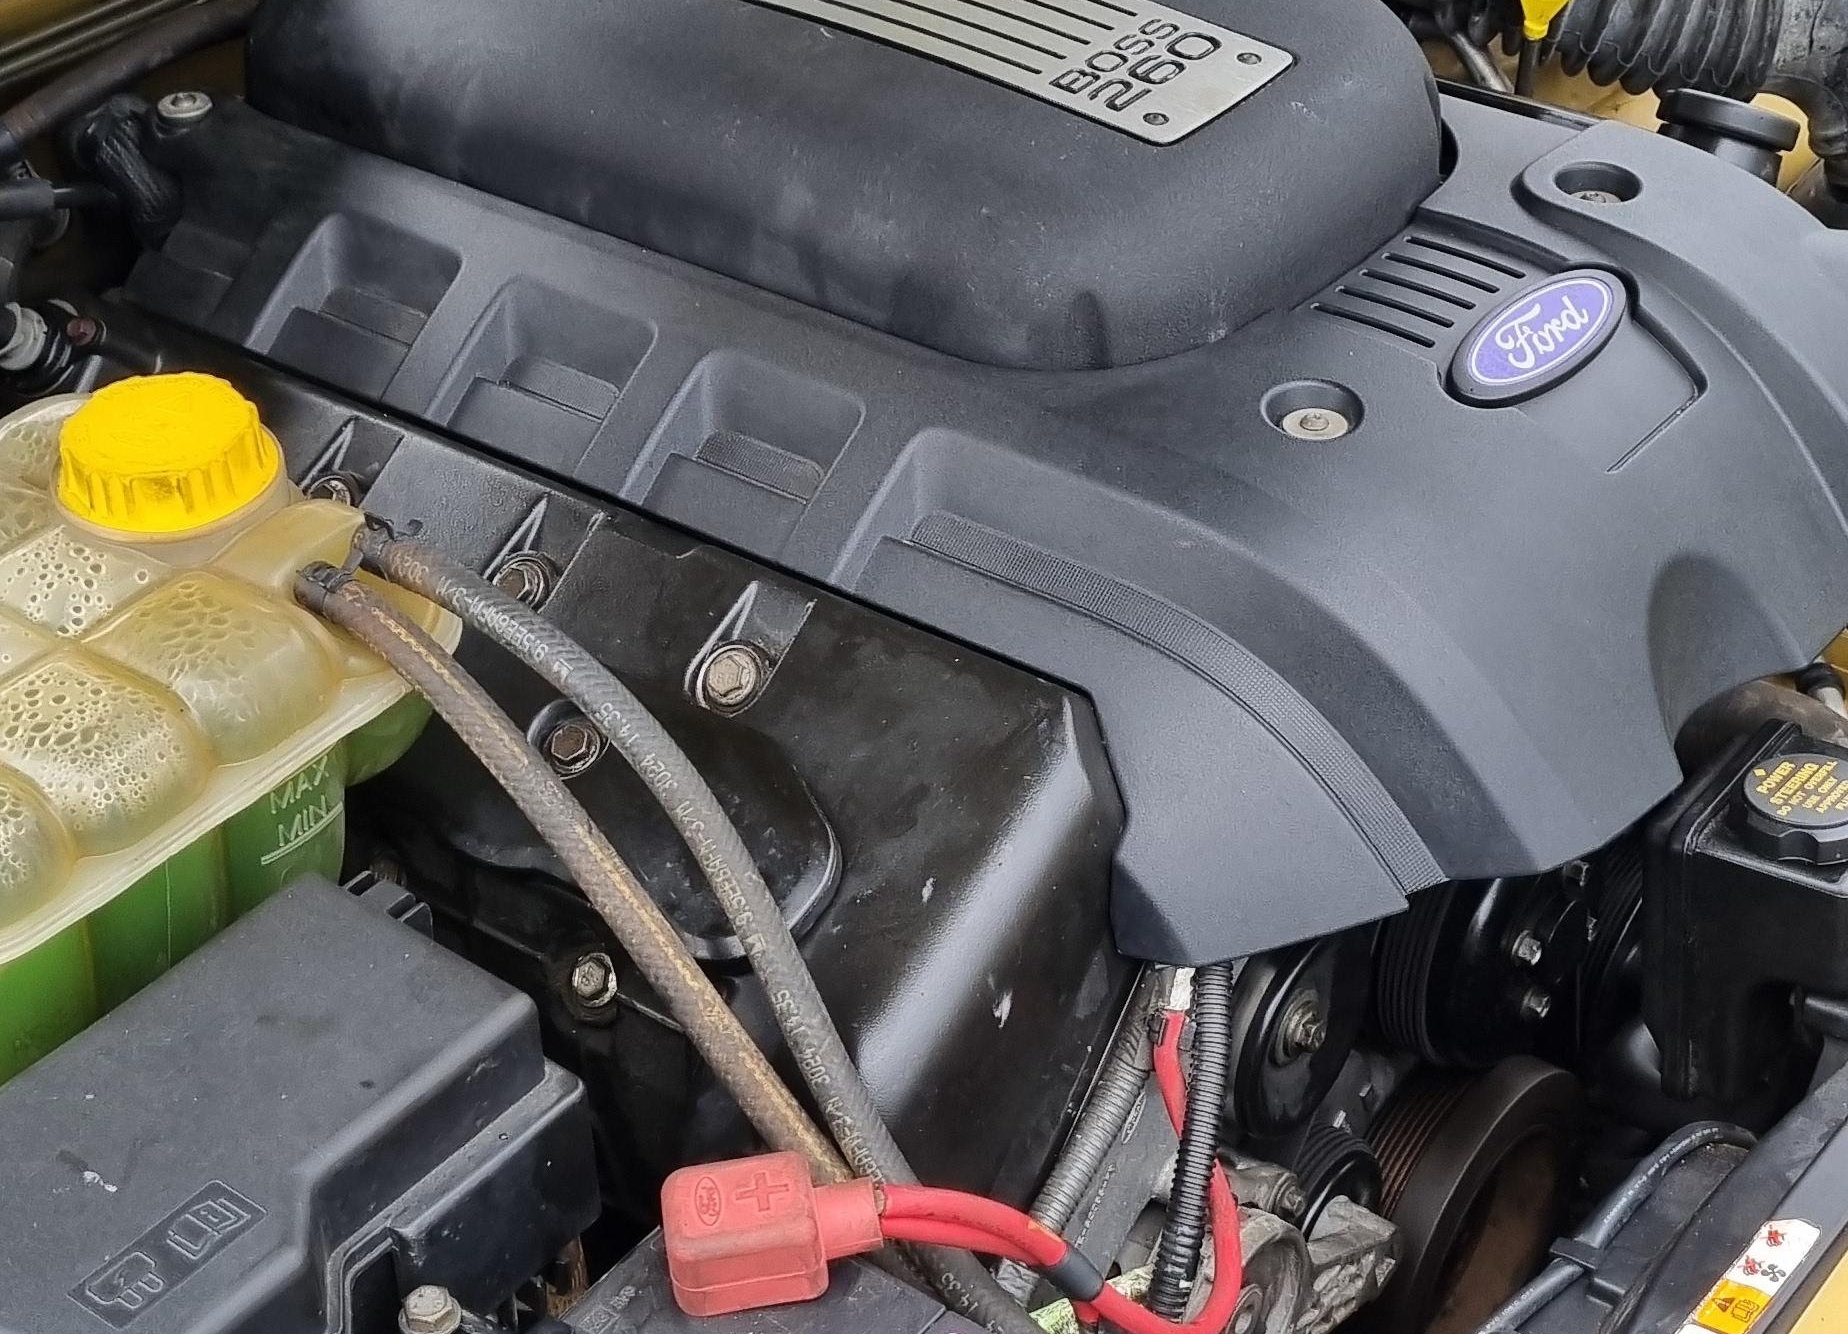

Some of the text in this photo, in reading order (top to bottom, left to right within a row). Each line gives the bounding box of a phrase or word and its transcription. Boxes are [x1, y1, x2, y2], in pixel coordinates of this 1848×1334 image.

[1049, 19, 1180, 94] BOSS
[1088, 32, 1222, 112] 260
[1493, 294, 1589, 367] Ford
[270, 755, 329, 815] MAX
[1756, 761, 1796, 794] POWER
[1769, 763, 1819, 805] STEERING
[1777, 761, 1838, 816] DO NOT OVERFILL
[1802, 776, 1838, 808] USE ONLY
[278, 794, 329, 847] MIN
[770, 990, 805, 1035] 14.35
[798, 1046, 830, 1089] 3024
